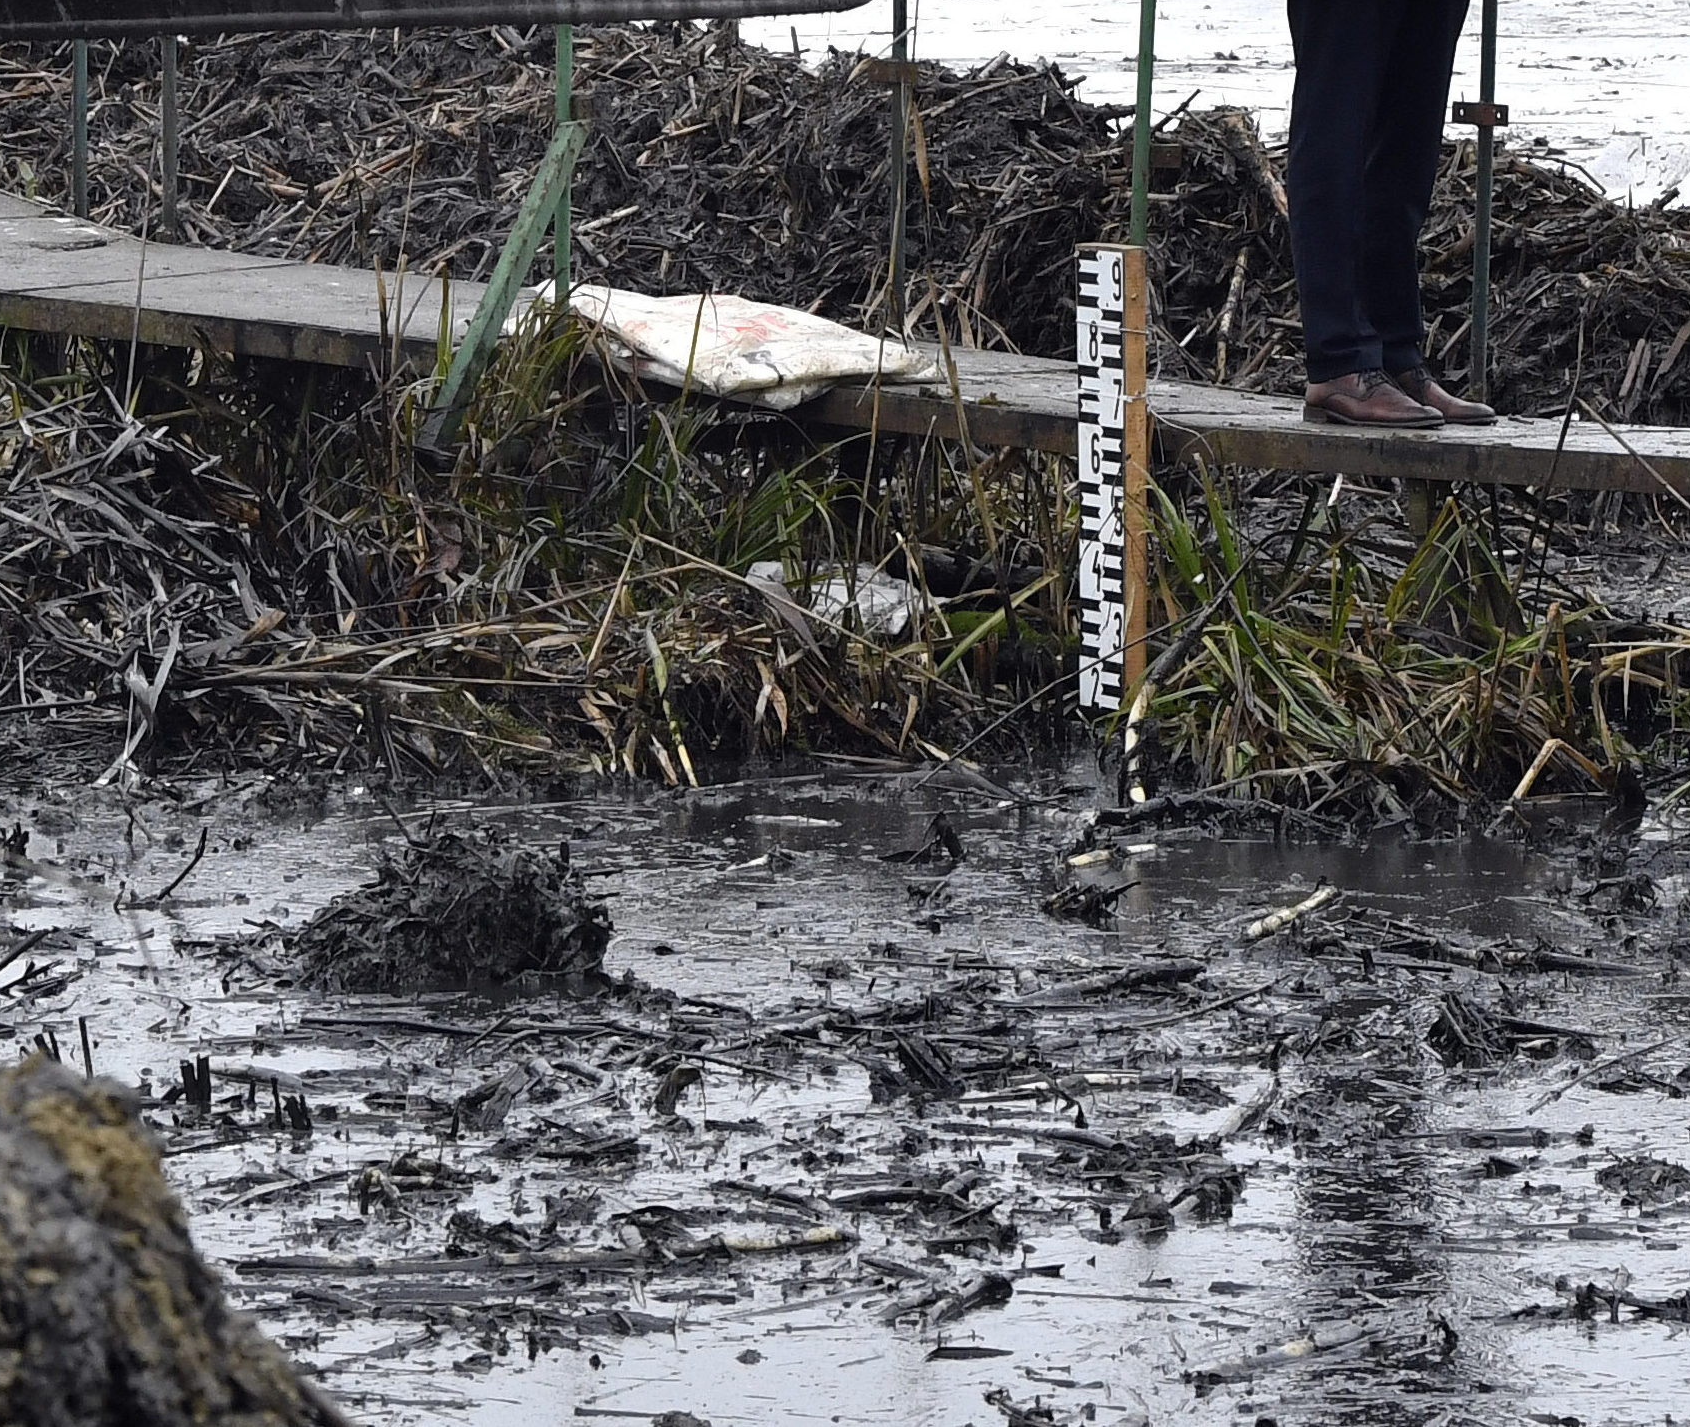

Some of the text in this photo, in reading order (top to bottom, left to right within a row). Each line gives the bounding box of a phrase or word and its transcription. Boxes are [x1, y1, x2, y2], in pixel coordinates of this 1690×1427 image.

[1112, 261, 1122, 302] 9
[1089, 321, 1099, 362] 8
[1112, 378, 1123, 421] 7
[1091, 432, 1101, 474] 6
[1092, 550, 1102, 592] 4
[1112, 612, 1123, 651] 3
[1091, 667, 1102, 704] 2
